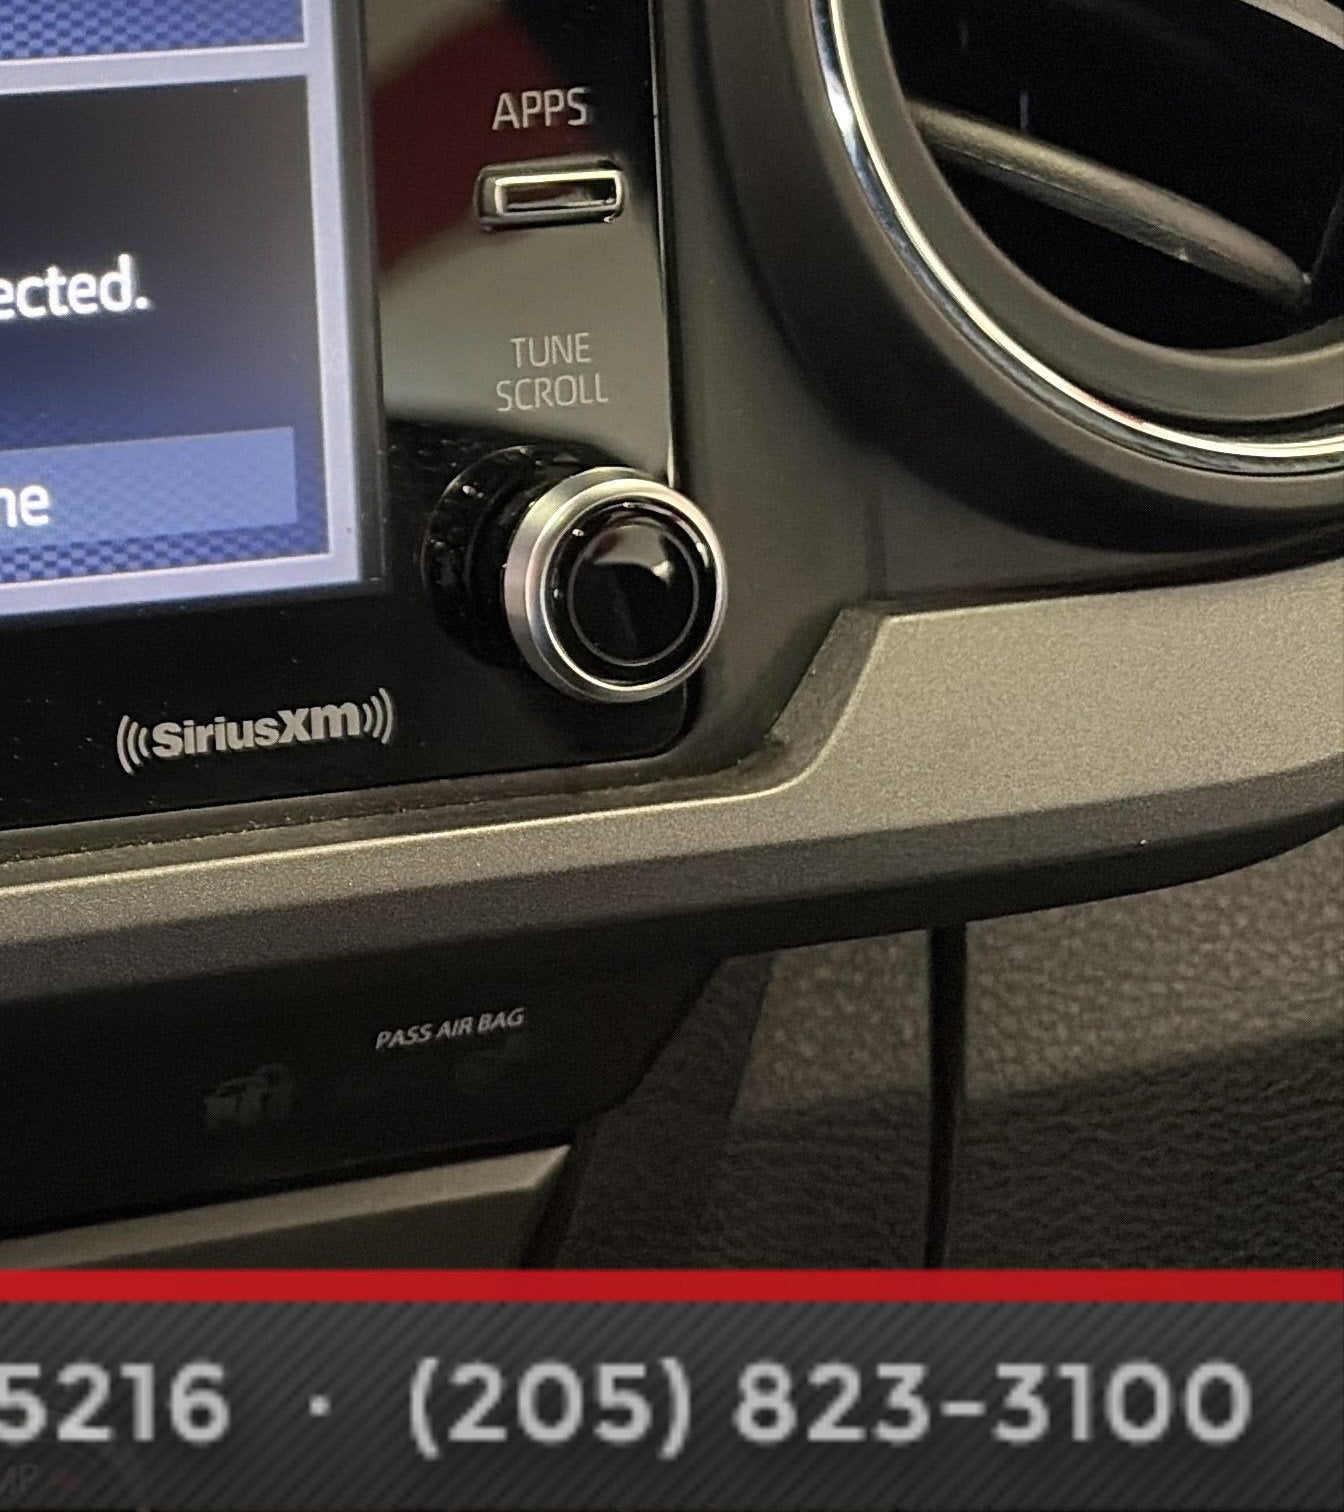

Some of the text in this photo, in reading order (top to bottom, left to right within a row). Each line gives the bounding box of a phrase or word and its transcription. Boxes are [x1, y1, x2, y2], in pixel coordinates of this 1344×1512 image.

[492, 87, 589, 130] APPS
[510, 332, 592, 369] TUNE
[496, 373, 609, 413] SCROLL
[375, 1006, 525, 1050] PASS AIR BAG
